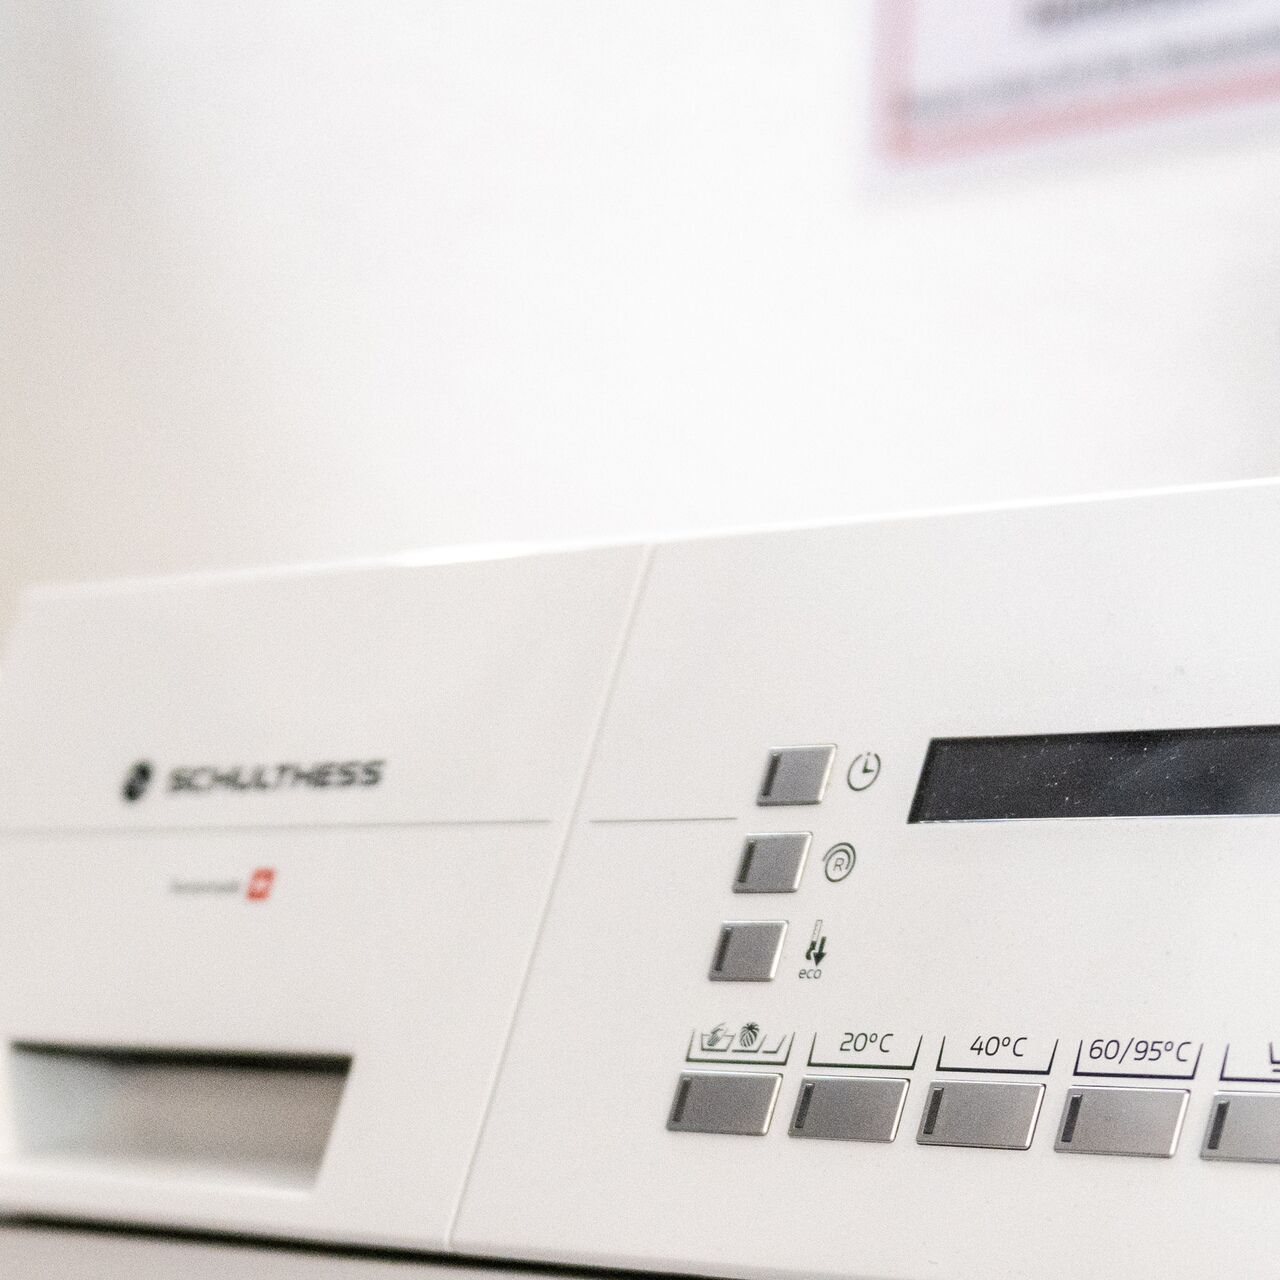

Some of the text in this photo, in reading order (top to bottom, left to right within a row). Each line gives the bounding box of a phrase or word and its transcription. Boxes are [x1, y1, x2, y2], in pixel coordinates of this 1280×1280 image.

[167, 760, 386, 793] SCHULTHESS
[798, 968, 823, 980] eco
[839, 1032, 894, 1054] 20°C
[969, 1036, 1028, 1058] 40°C
[1088, 1037, 1192, 1065] 60/95°C
